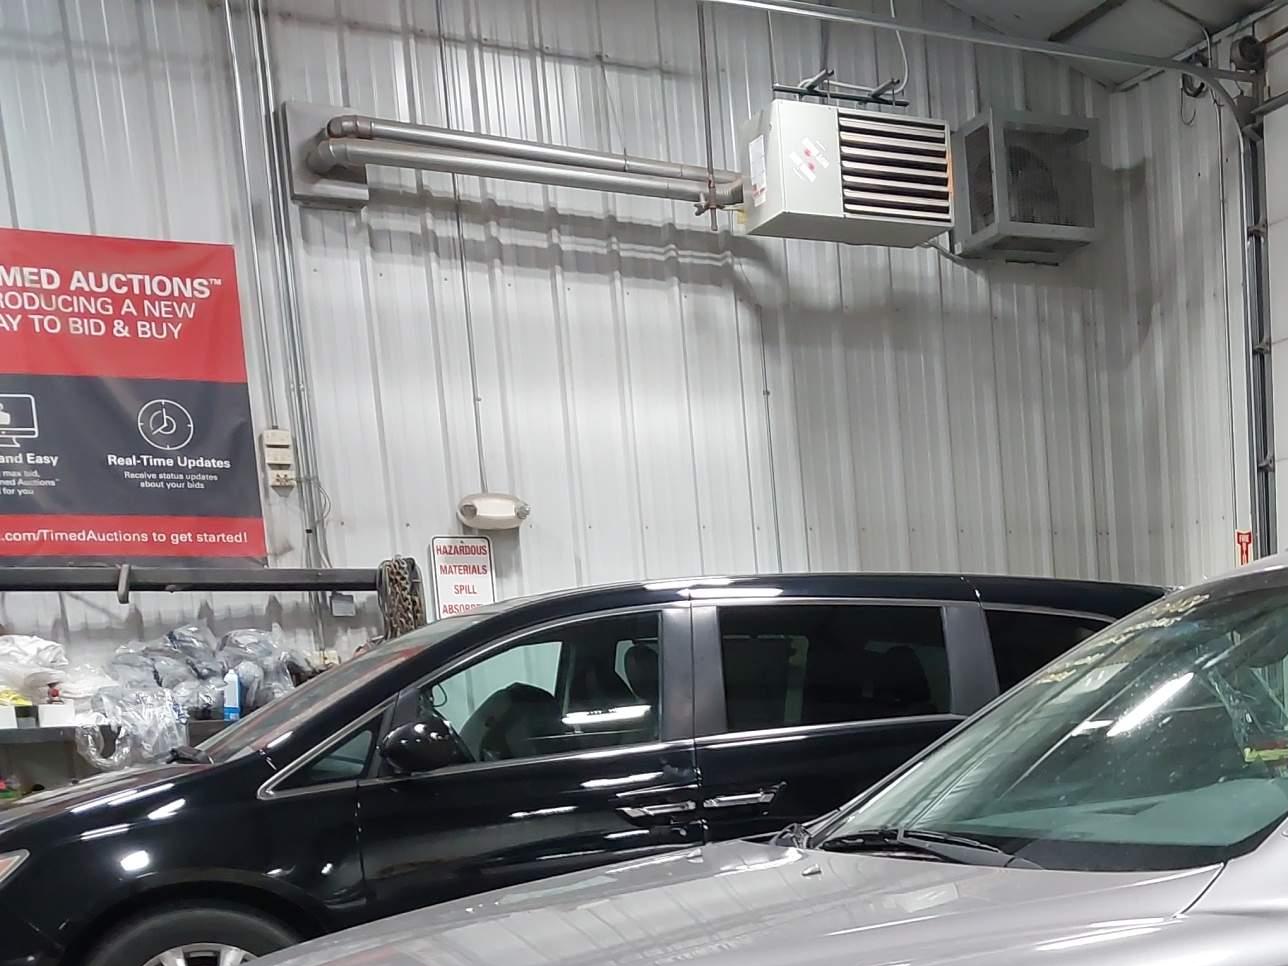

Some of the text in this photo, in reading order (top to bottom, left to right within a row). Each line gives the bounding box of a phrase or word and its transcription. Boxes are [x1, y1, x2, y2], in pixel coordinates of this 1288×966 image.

[121, 298, 138, 316] A
[143, 299, 196, 319] NEW
[28, 314, 61, 334] TO
[68, 317, 106, 336] BID
[112, 319, 131, 338] &
[136, 320, 182, 340] BUY
[26, 452, 59, 467] Easy
[107, 454, 231, 469] Real-Time Updates
[158, 472, 184, 480] status
[185, 473, 218, 482] updates
[140, 481, 205, 490] about your bids
[152, 532, 166, 543] to
[170, 532, 193, 545] get
[196, 532, 248, 544] started!
[436, 545, 488, 556] HAZARDOUS
[440, 564, 488, 576] MATERIALS
[453, 584, 477, 595] SPILL
